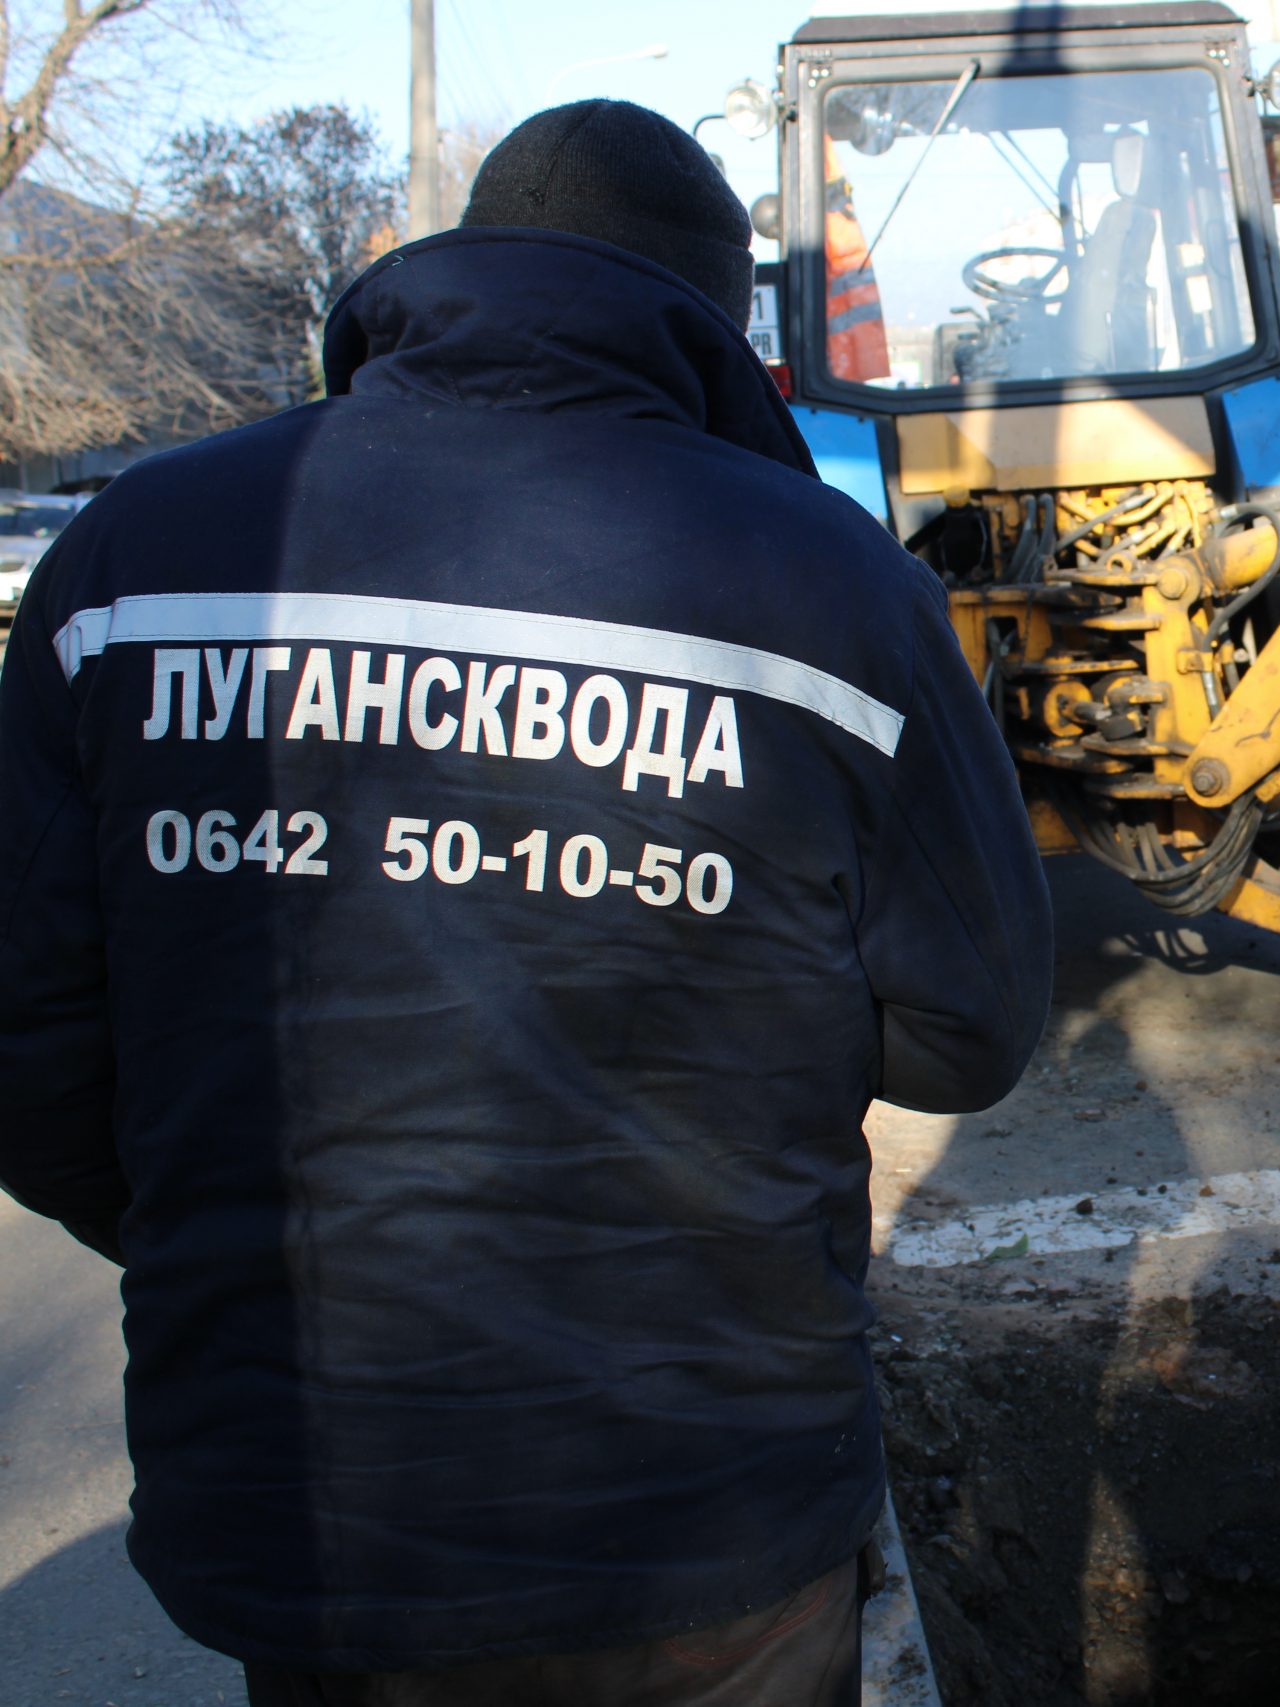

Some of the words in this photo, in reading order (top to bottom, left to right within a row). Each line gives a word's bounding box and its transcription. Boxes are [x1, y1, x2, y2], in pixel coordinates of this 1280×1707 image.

[144, 647, 745, 798] ЛУГАНСКВОДА
[147, 810, 328, 875] 0642
[382, 817, 733, 914] 50-10-50
